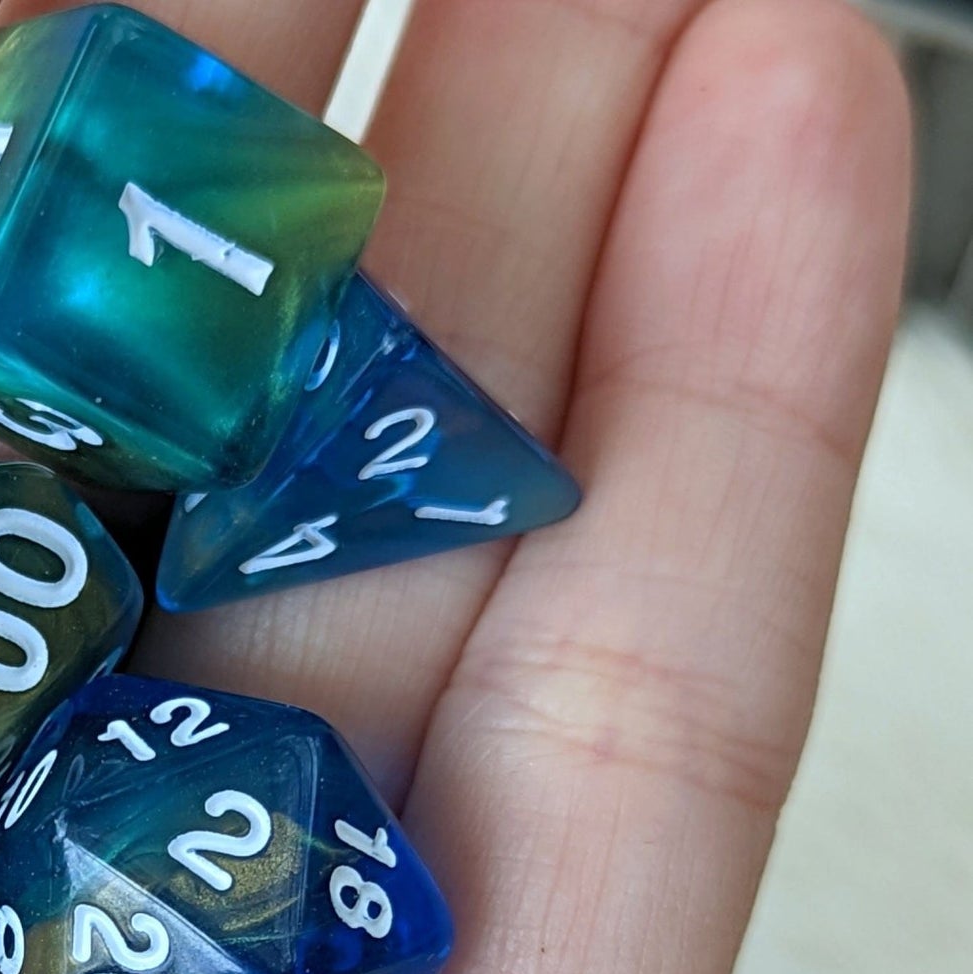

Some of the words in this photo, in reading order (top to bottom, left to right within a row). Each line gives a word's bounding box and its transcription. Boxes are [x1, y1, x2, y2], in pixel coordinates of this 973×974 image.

[118, 181, 274, 296] 1
[359, 408, 435, 480] 2
[239, 515, 338, 572] 4
[98, 697, 230, 761] 12
[168, 789, 272, 891] 2
[329, 819, 397, 939] 18
